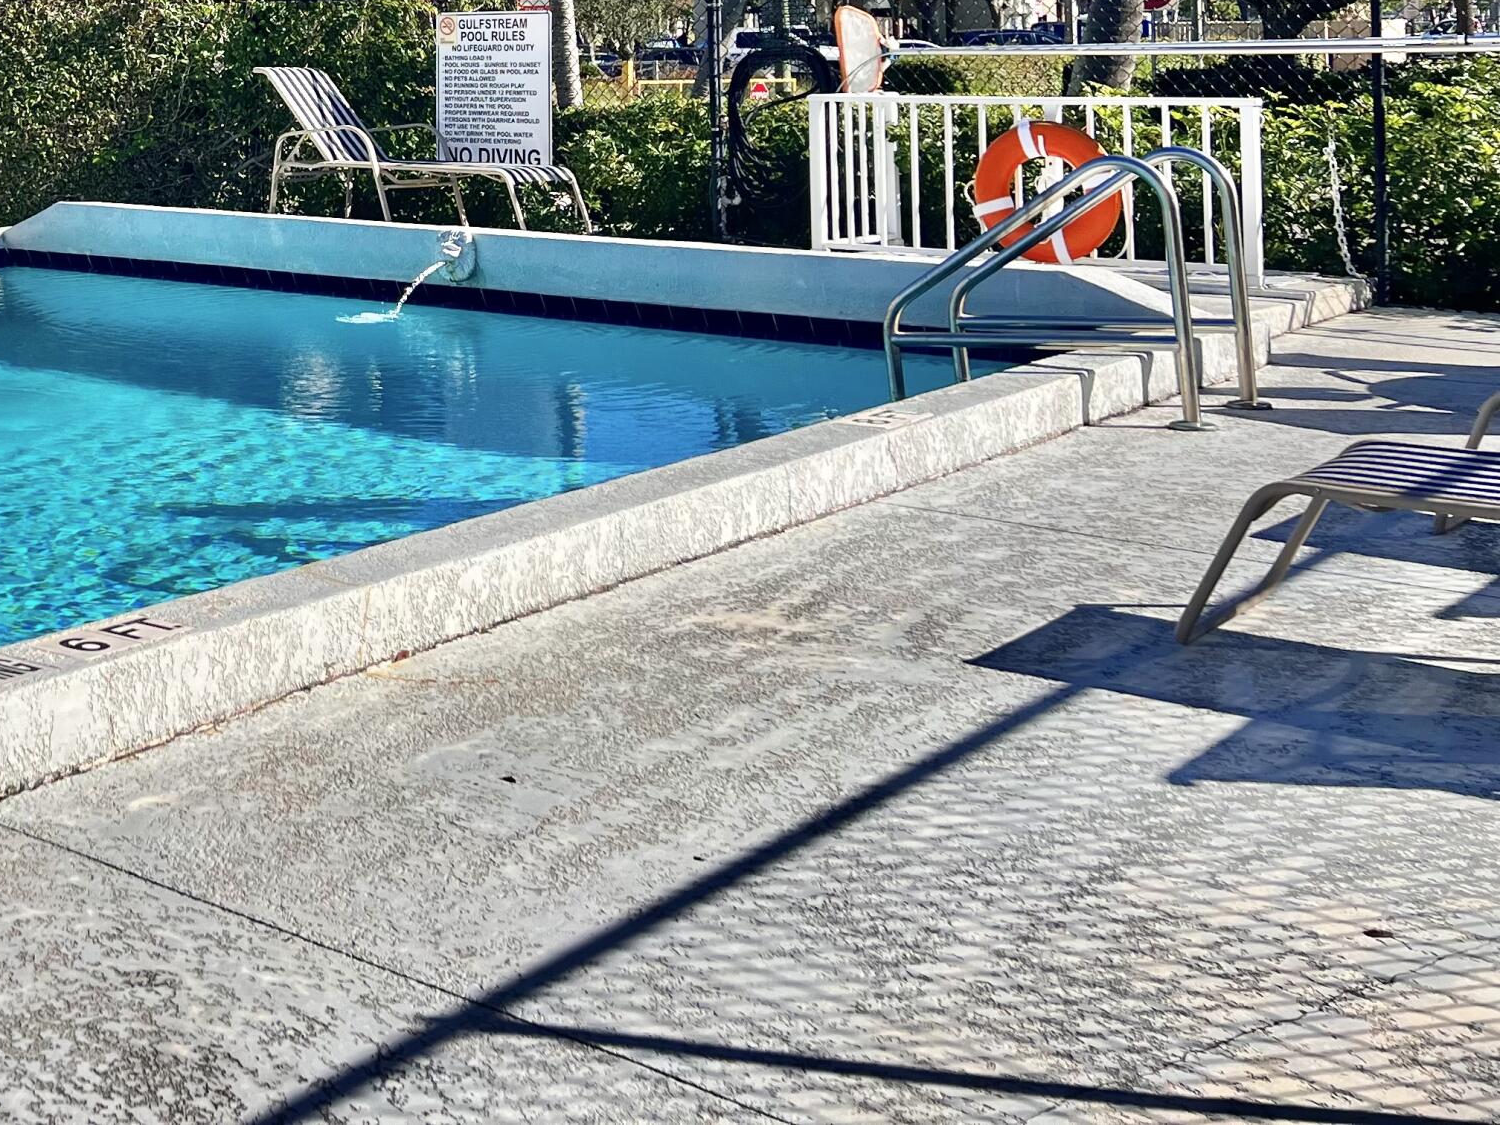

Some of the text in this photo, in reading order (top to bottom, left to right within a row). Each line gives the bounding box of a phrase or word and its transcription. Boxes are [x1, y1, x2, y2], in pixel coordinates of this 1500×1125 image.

[458, 18, 528, 29] GULFSTREAM
[460, 32, 488, 42] POOL
[491, 31, 526, 42] RULES
[451, 43, 535, 52] NO LIFEGUARD ON DUTY
[448, 146, 541, 165] NO DIVING
[59, 637, 111, 651] 6
